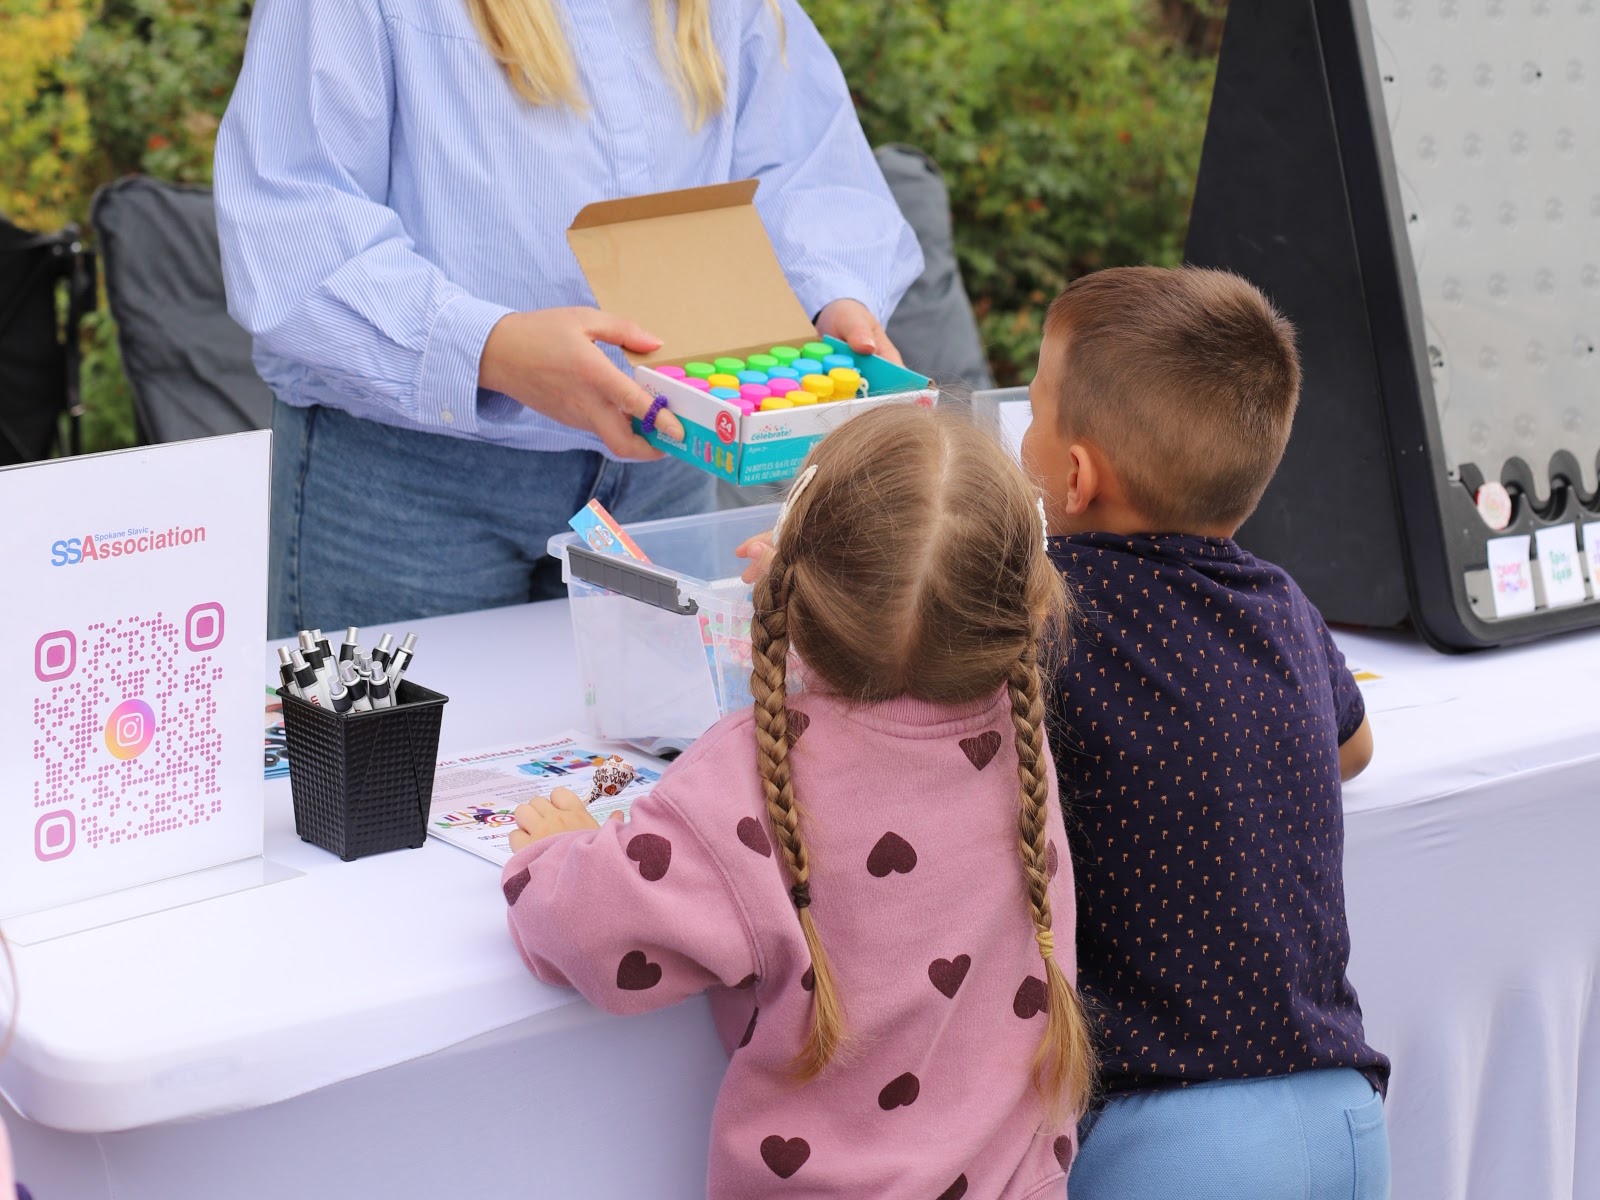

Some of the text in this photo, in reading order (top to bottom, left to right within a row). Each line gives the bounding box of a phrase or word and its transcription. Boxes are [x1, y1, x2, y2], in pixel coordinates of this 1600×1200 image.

[720, 416, 733, 433] 24
[751, 429, 792, 441] celebrate!
[94, 526, 149, 542] Spokane Slavic
[459, 748, 523, 763] Business
[525, 738, 573, 751] School
